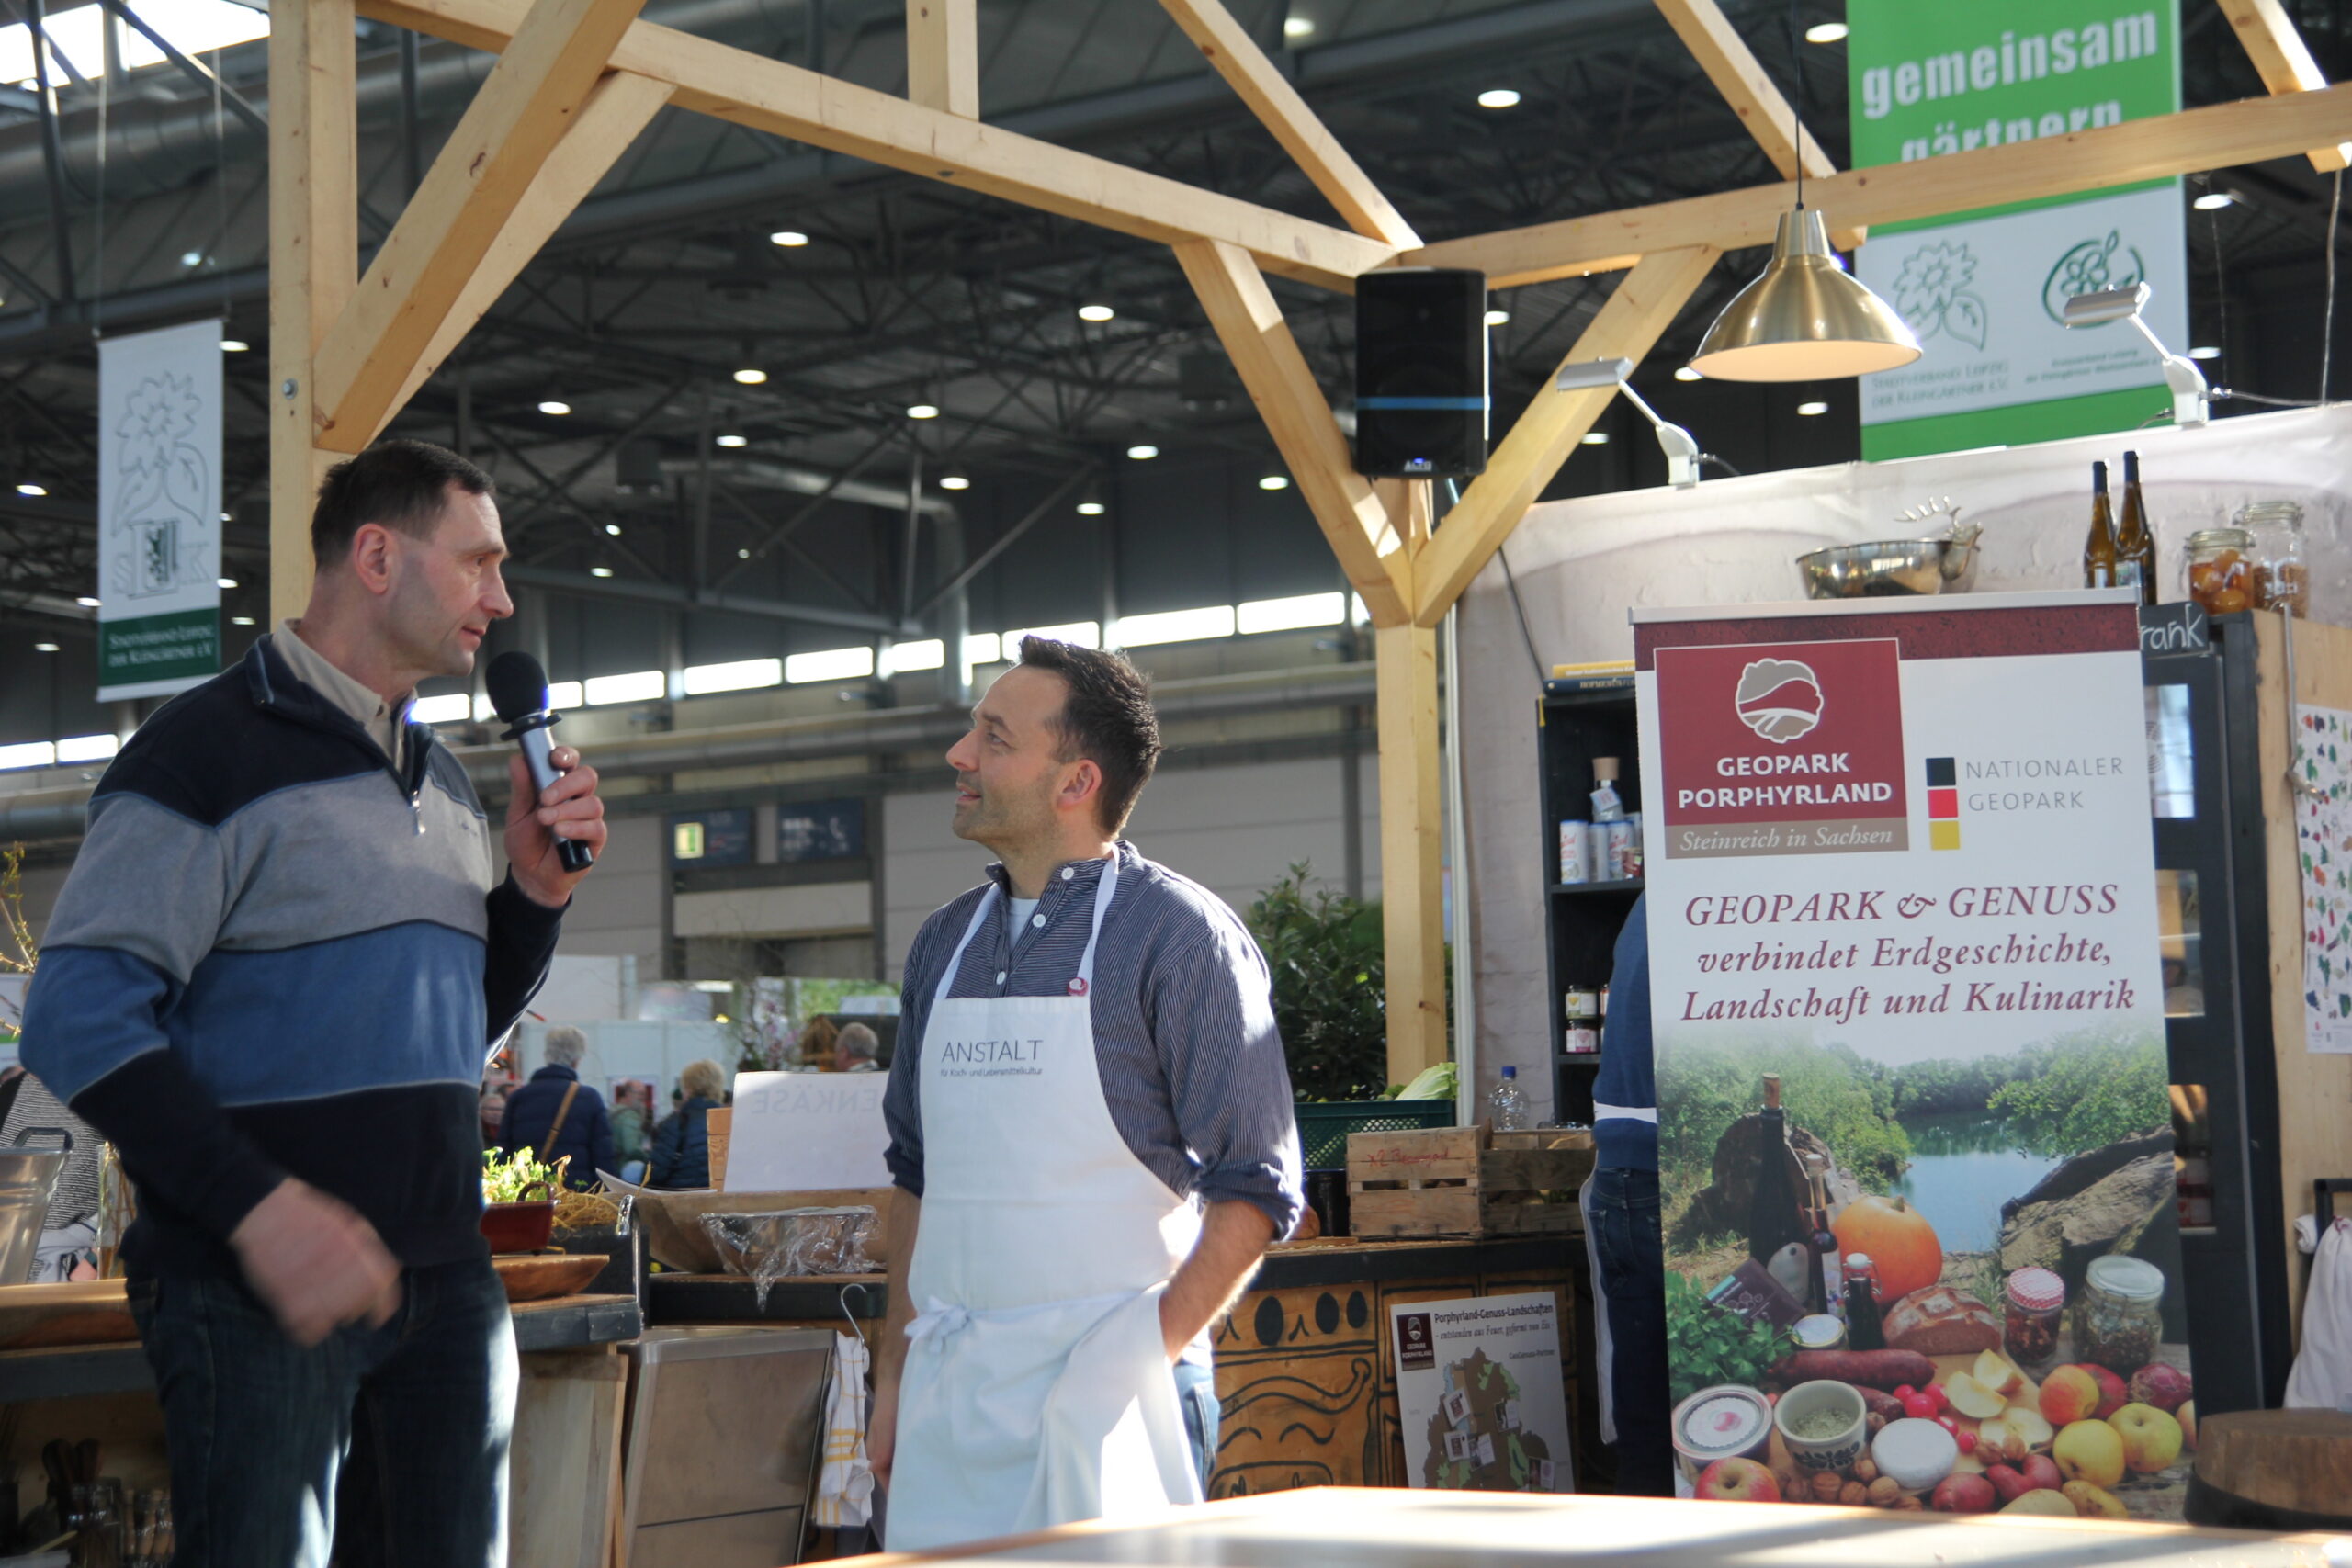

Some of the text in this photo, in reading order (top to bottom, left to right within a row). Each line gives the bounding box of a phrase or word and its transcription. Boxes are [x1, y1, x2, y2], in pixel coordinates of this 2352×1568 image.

[1862, 10, 2157, 120] gemeinsam
[1716, 752, 1850, 777] GEOPARK
[1966, 757, 2124, 779] NATIONALER
[1679, 782, 1893, 809] PORPHYRLAND
[1968, 791, 2084, 812] GEOPARK
[1679, 825, 1893, 852] Steinreich in Sachsen
[1685, 884, 2119, 926] GEOPARK & GENUSS
[1697, 932, 2110, 975] verbindet Erdgeschichte,
[1680, 978, 2136, 1025] Landschaft und Kulinarik
[941, 1039, 1044, 1063] ANSTALT
[1434, 1303, 1554, 1325] Porphyrland-Genuss-Landschaften
